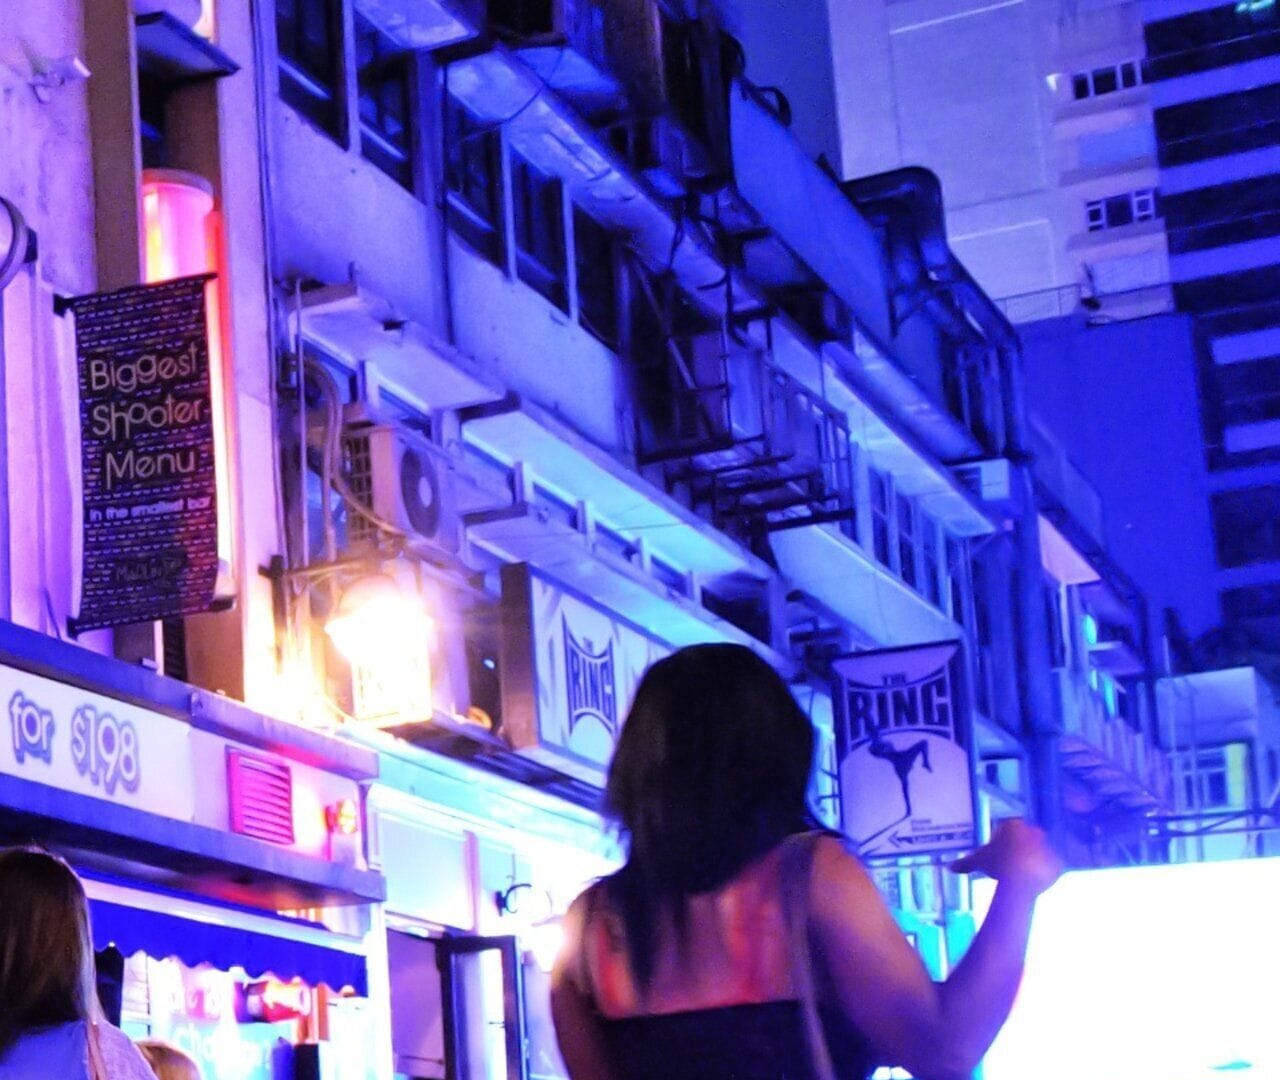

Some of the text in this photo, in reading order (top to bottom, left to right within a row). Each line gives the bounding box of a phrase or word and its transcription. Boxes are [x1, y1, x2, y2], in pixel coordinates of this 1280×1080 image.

[90, 341, 199, 393] Biggest
[92, 393, 203, 441] Shooter
[106, 449, 196, 490] Menu
[848, 675, 951, 744] RING
[10, 694, 54, 751] for
[72, 708, 139, 784] $198
